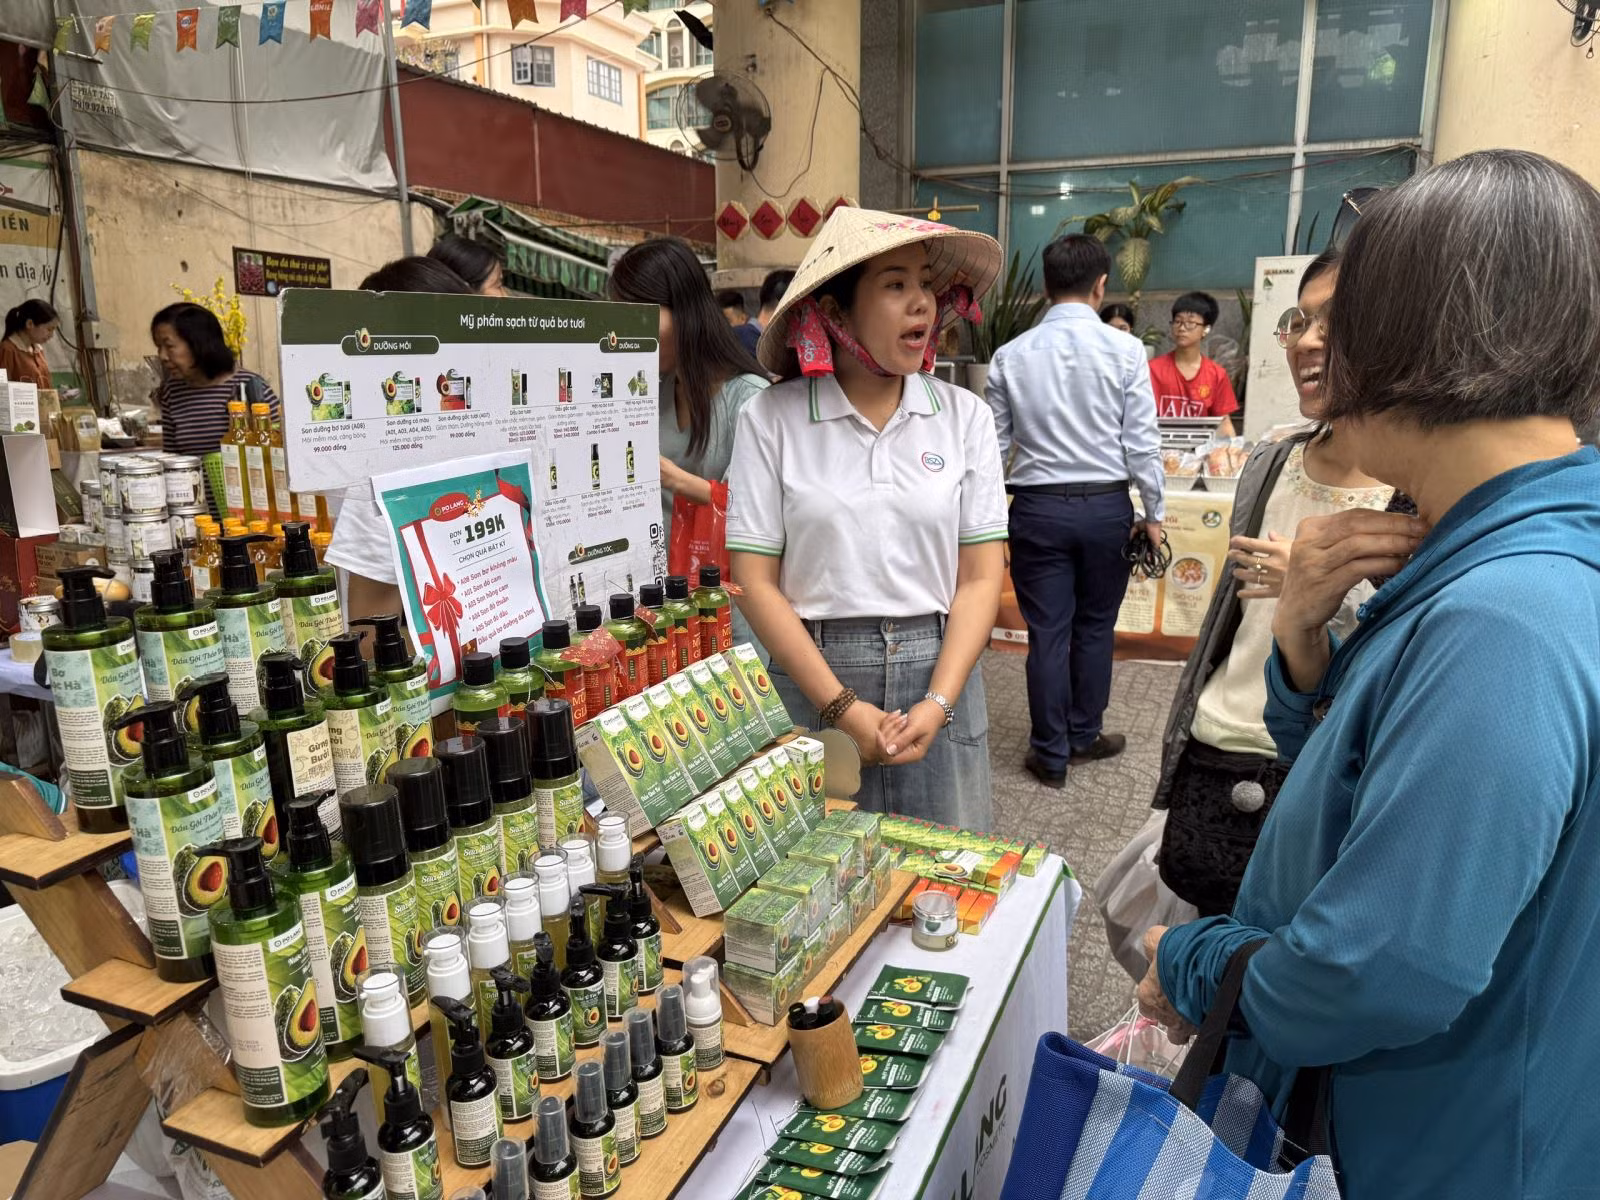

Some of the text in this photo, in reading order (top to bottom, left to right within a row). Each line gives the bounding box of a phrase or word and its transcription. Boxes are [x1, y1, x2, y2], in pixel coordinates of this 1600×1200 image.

[16, 262, 36, 283] địa
[460, 313, 586, 330] Mỹ phẩm sạch từ quả bơ tươi
[374, 340, 412, 350] DƯỠNG MÔI
[450, 500, 464, 510] LANG
[464, 514, 506, 543] 199K
[475, 548, 488, 559] QUÀ
[470, 572, 481, 580] Son
[490, 562, 506, 574] không
[473, 584, 483, 593] Son
[491, 576, 502, 584] cam
[476, 594, 486, 604] Son
[64, 679, 81, 690] Hà
[308, 739, 328, 753] Gừng
[311, 750, 330, 764] Bưởi
